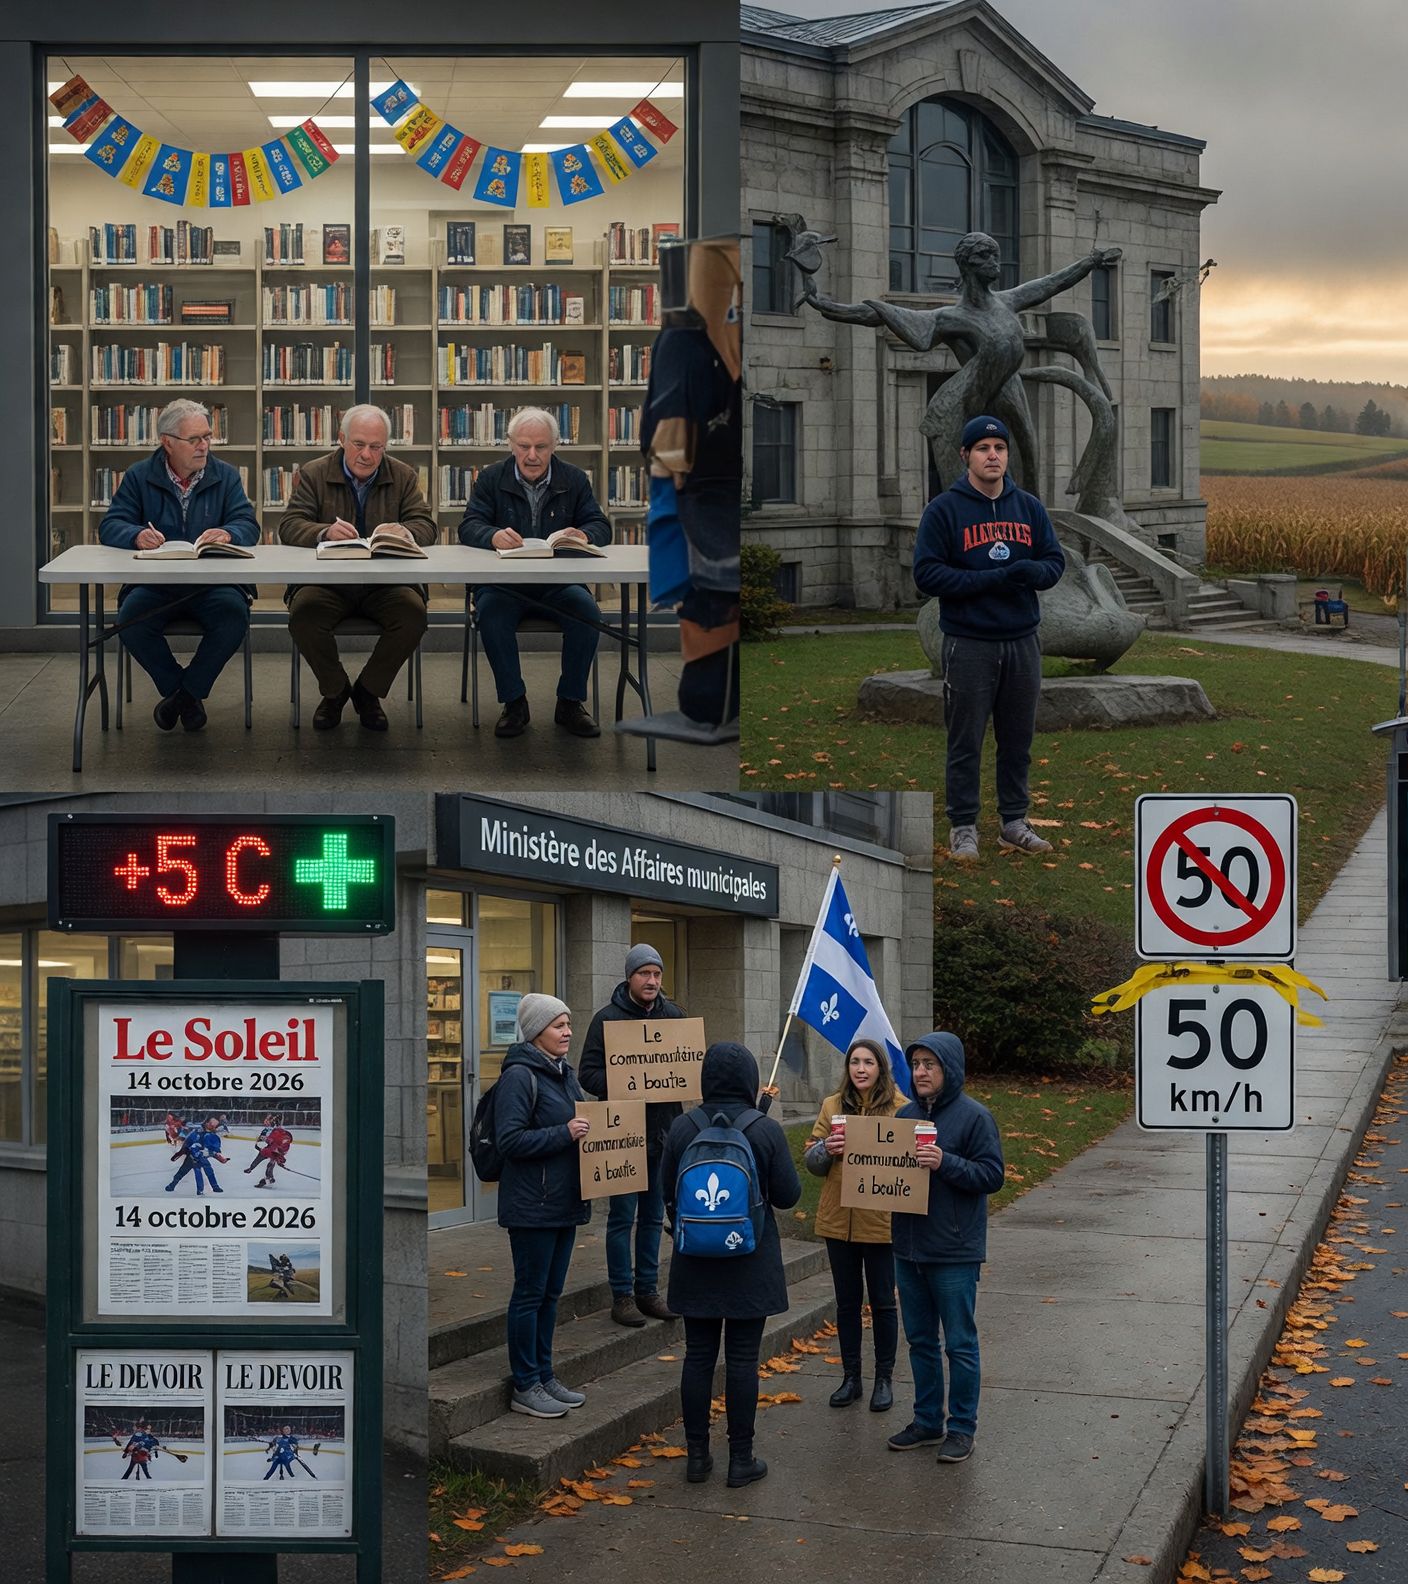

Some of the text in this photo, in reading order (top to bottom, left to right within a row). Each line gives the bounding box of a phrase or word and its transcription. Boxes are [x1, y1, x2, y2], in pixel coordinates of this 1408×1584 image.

[114, 835, 271, 905] +5 C
[481, 817, 767, 902] Ministère des Affaires municipales
[1176, 846, 1259, 909] 50
[113, 1017, 319, 1061] Le Soleil
[643, 1024, 662, 1043] Le
[1166, 999, 1268, 1069] 50
[128, 1072, 304, 1091] 14 octobre 2026
[628, 1076, 636, 1090] à
[1170, 1082, 1263, 1113] km/h
[606, 1108, 621, 1128] Le
[877, 1122, 895, 1143] Le
[115, 1206, 316, 1229] 14 octobre 2026
[85, 1363, 204, 1389] LE DEVOIR
[225, 1364, 343, 1390] LE DEVOIR
